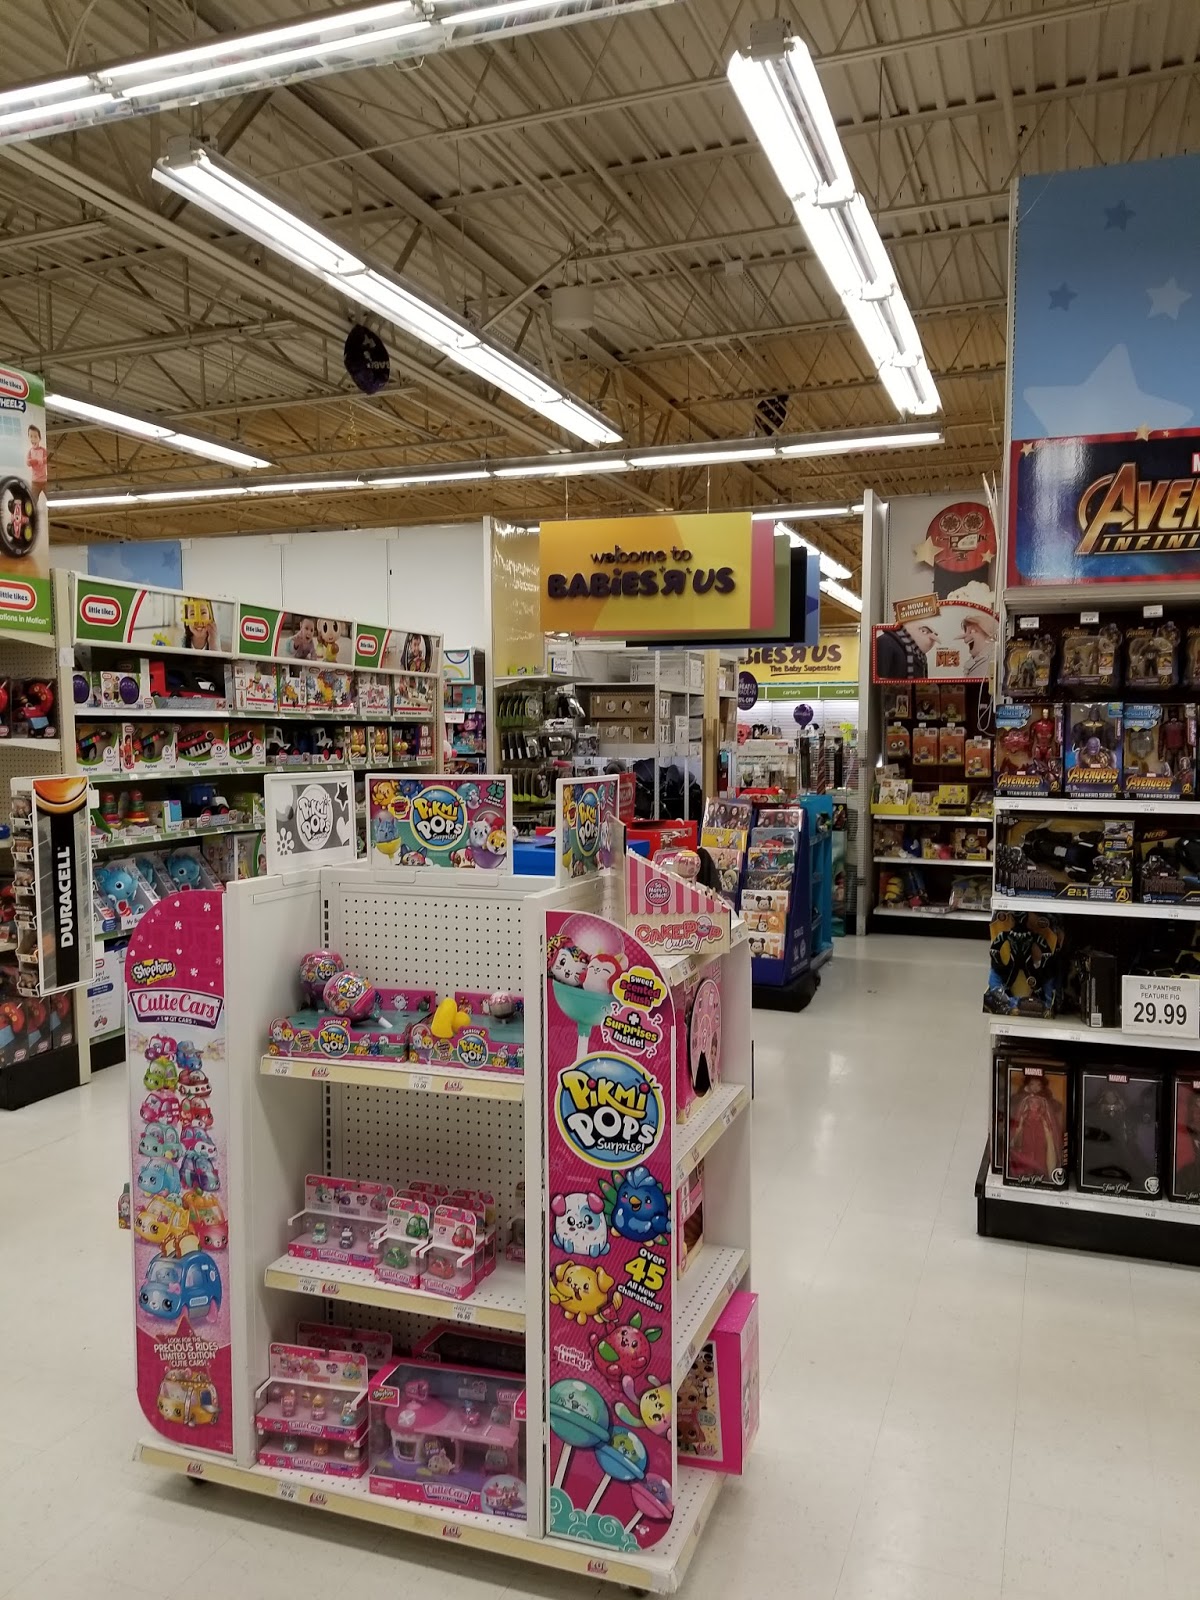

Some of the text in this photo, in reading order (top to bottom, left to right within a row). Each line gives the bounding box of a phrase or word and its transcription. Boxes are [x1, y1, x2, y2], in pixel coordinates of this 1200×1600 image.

[591, 545, 693, 564] welcome to
[88, 606, 115, 616] little tikes
[900, 607, 933, 618] SHOWING
[907, 602, 924, 610] NOW
[784, 665, 802, 673] Baby
[804, 664, 841, 673] Superstore
[1067, 765, 1119, 783] AVENGERS
[487, 782, 505, 799] 45
[301, 815, 331, 842] POPS
[417, 815, 463, 840] POPS
[57, 846, 74, 948] DURACELL
[133, 959, 173, 979] Shopkins
[1141, 992, 1169, 1000] FEATURE
[1152, 984, 1182, 992] PANTHER
[1133, 1001, 1187, 1026] 29.99
[322, 1041, 348, 1053] POPS
[613, 1031, 644, 1048] Inside!
[461, 1050, 486, 1062] POPS
[1025, 1068, 1043, 1076] MARVEL
[1109, 1074, 1127, 1083] MARVEL
[566, 1105, 656, 1147] POPS
[596, 1137, 646, 1154] Surprise!
[639, 1248, 665, 1265] Over
[625, 1256, 667, 1290] 45
[627, 1280, 656, 1299] All New
[154, 1342, 219, 1353] PRECIOUS RIDES
[160, 1351, 216, 1360] LIMITED EDITION
